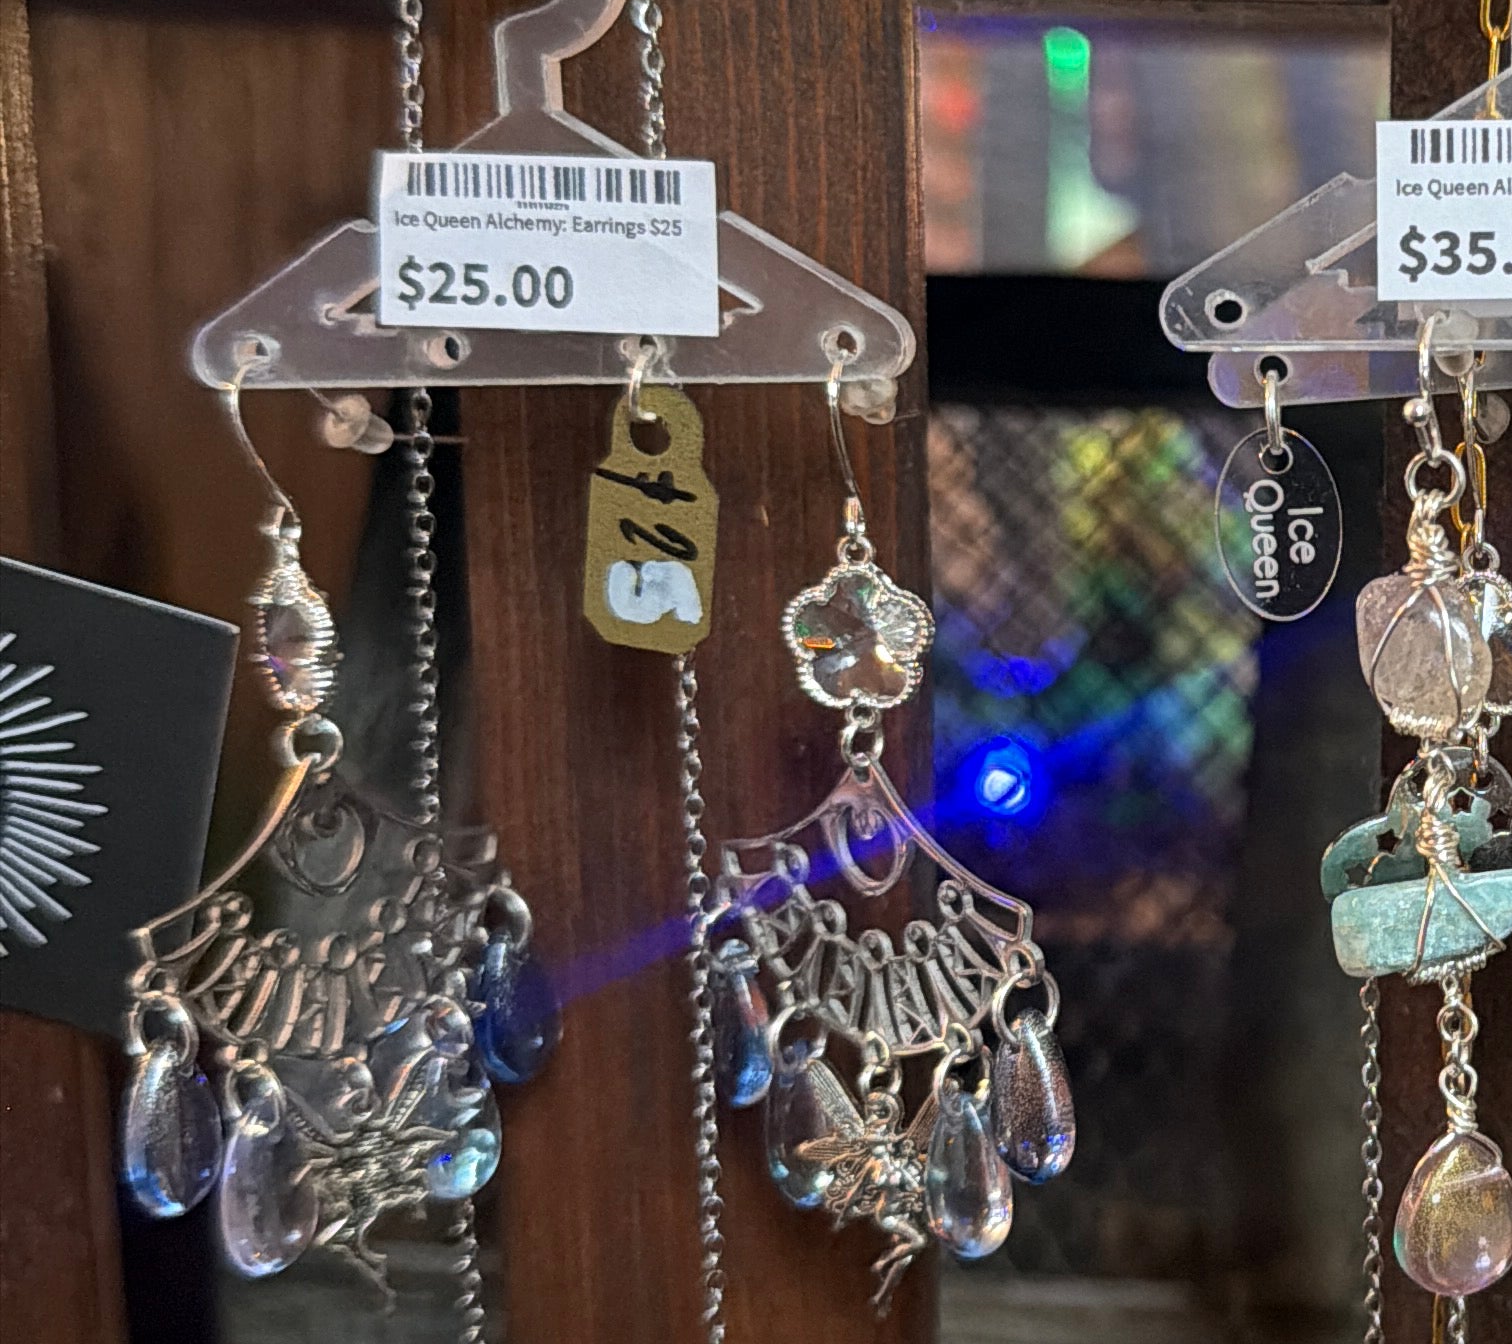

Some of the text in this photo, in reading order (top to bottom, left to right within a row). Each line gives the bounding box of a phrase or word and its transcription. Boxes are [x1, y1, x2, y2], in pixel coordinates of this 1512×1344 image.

[1396, 179, 1423, 196] Ice
[1427, 178, 1490, 199] Queen
[395, 210, 682, 239] Ice Queen Alchemy: Earrings $25
[398, 255, 574, 311] $25.00
[1243, 479, 1284, 599] Queen
[1287, 506, 1324, 565] Ice
